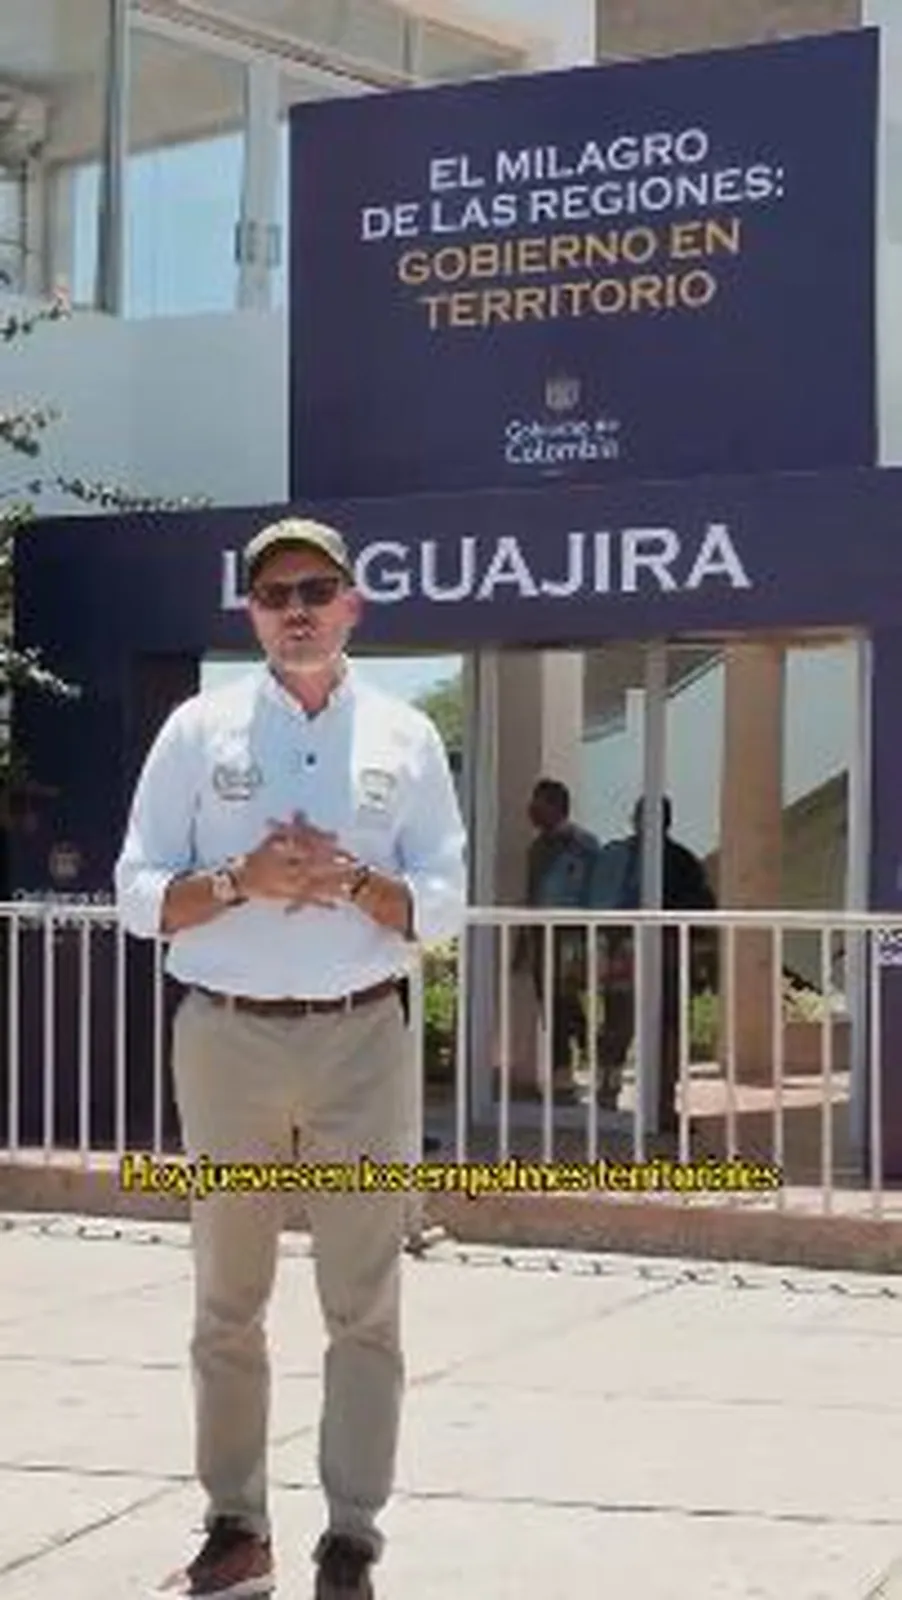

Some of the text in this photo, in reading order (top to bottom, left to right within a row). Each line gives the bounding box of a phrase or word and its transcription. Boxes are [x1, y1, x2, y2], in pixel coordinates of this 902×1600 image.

[429, 129, 709, 192] EL MILAGRO
[361, 166, 786, 241] DE LAS REGIONES:
[398, 219, 741, 285] GOBIERNO EN
[419, 270, 716, 330] TERRITORIO
[354, 524, 751, 602] GUAJIRA
